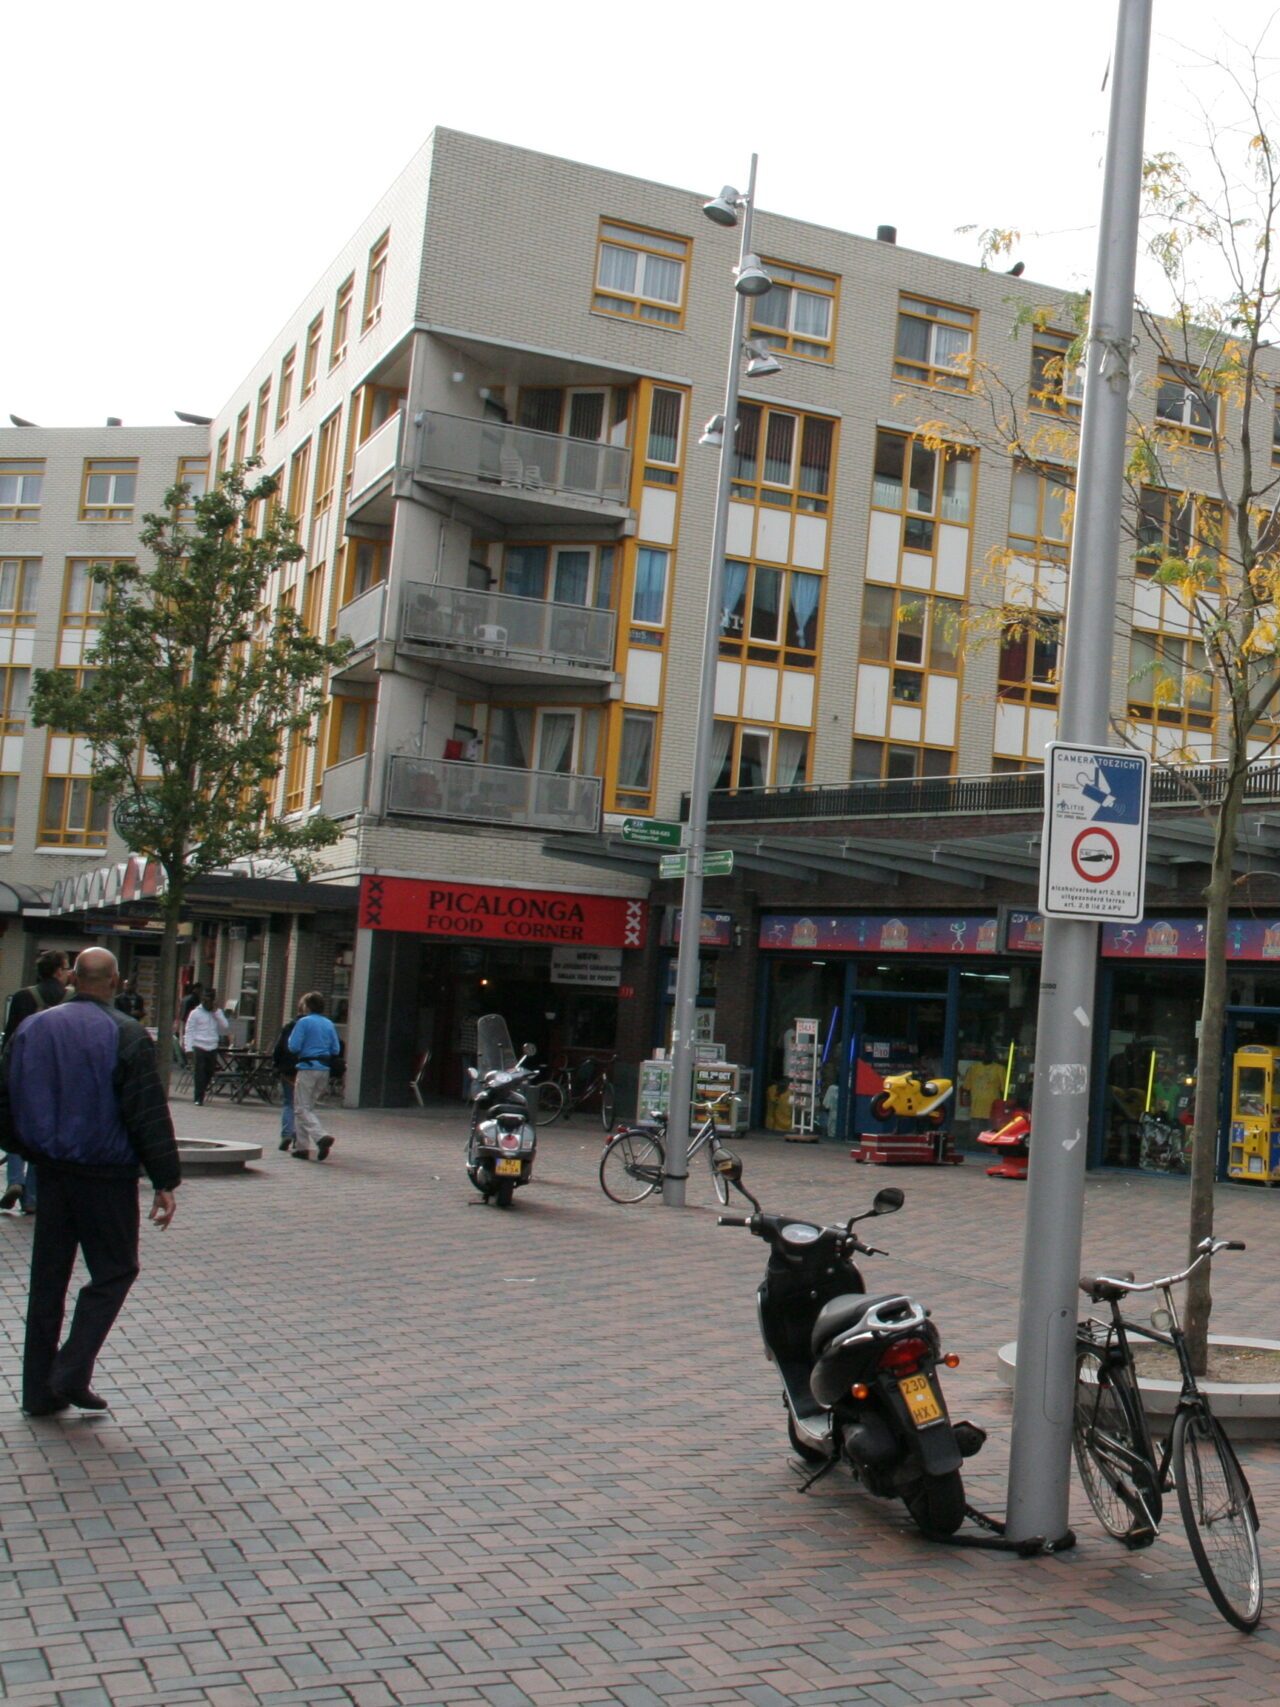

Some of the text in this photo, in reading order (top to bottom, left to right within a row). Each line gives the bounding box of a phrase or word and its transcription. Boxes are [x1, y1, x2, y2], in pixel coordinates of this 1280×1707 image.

[428, 890, 585, 923] PICALONGA
[426, 914, 584, 941] FOOD CORNER
[901, 1377, 927, 1394] 23D
